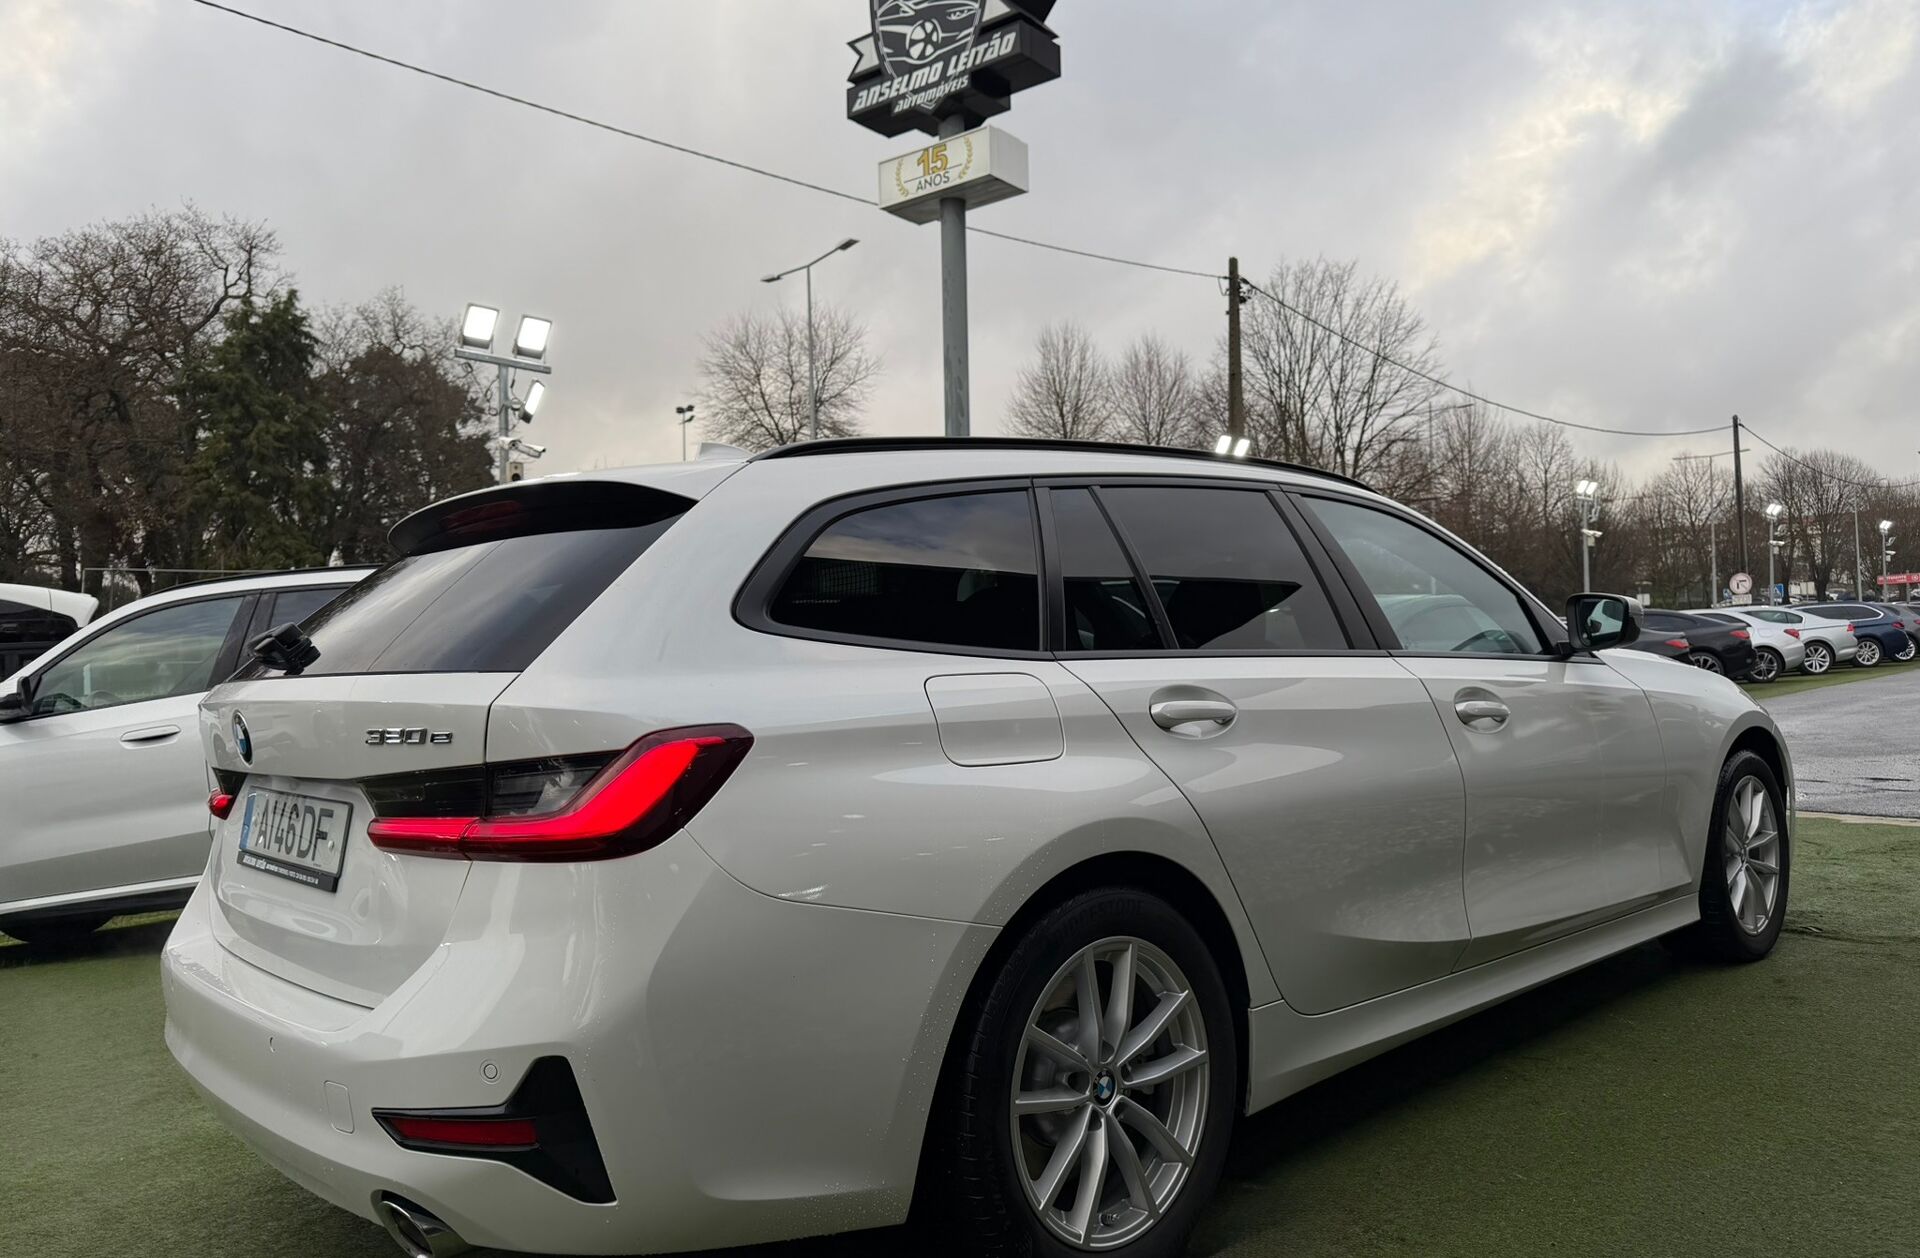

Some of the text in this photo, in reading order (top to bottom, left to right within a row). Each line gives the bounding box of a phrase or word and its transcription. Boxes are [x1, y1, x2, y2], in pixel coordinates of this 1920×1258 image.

[852, 32, 1016, 112] ANSELMO LEITÃO
[917, 144, 948, 176] 15
[916, 170, 950, 193] ANOS
[365, 728, 428, 745] 330
